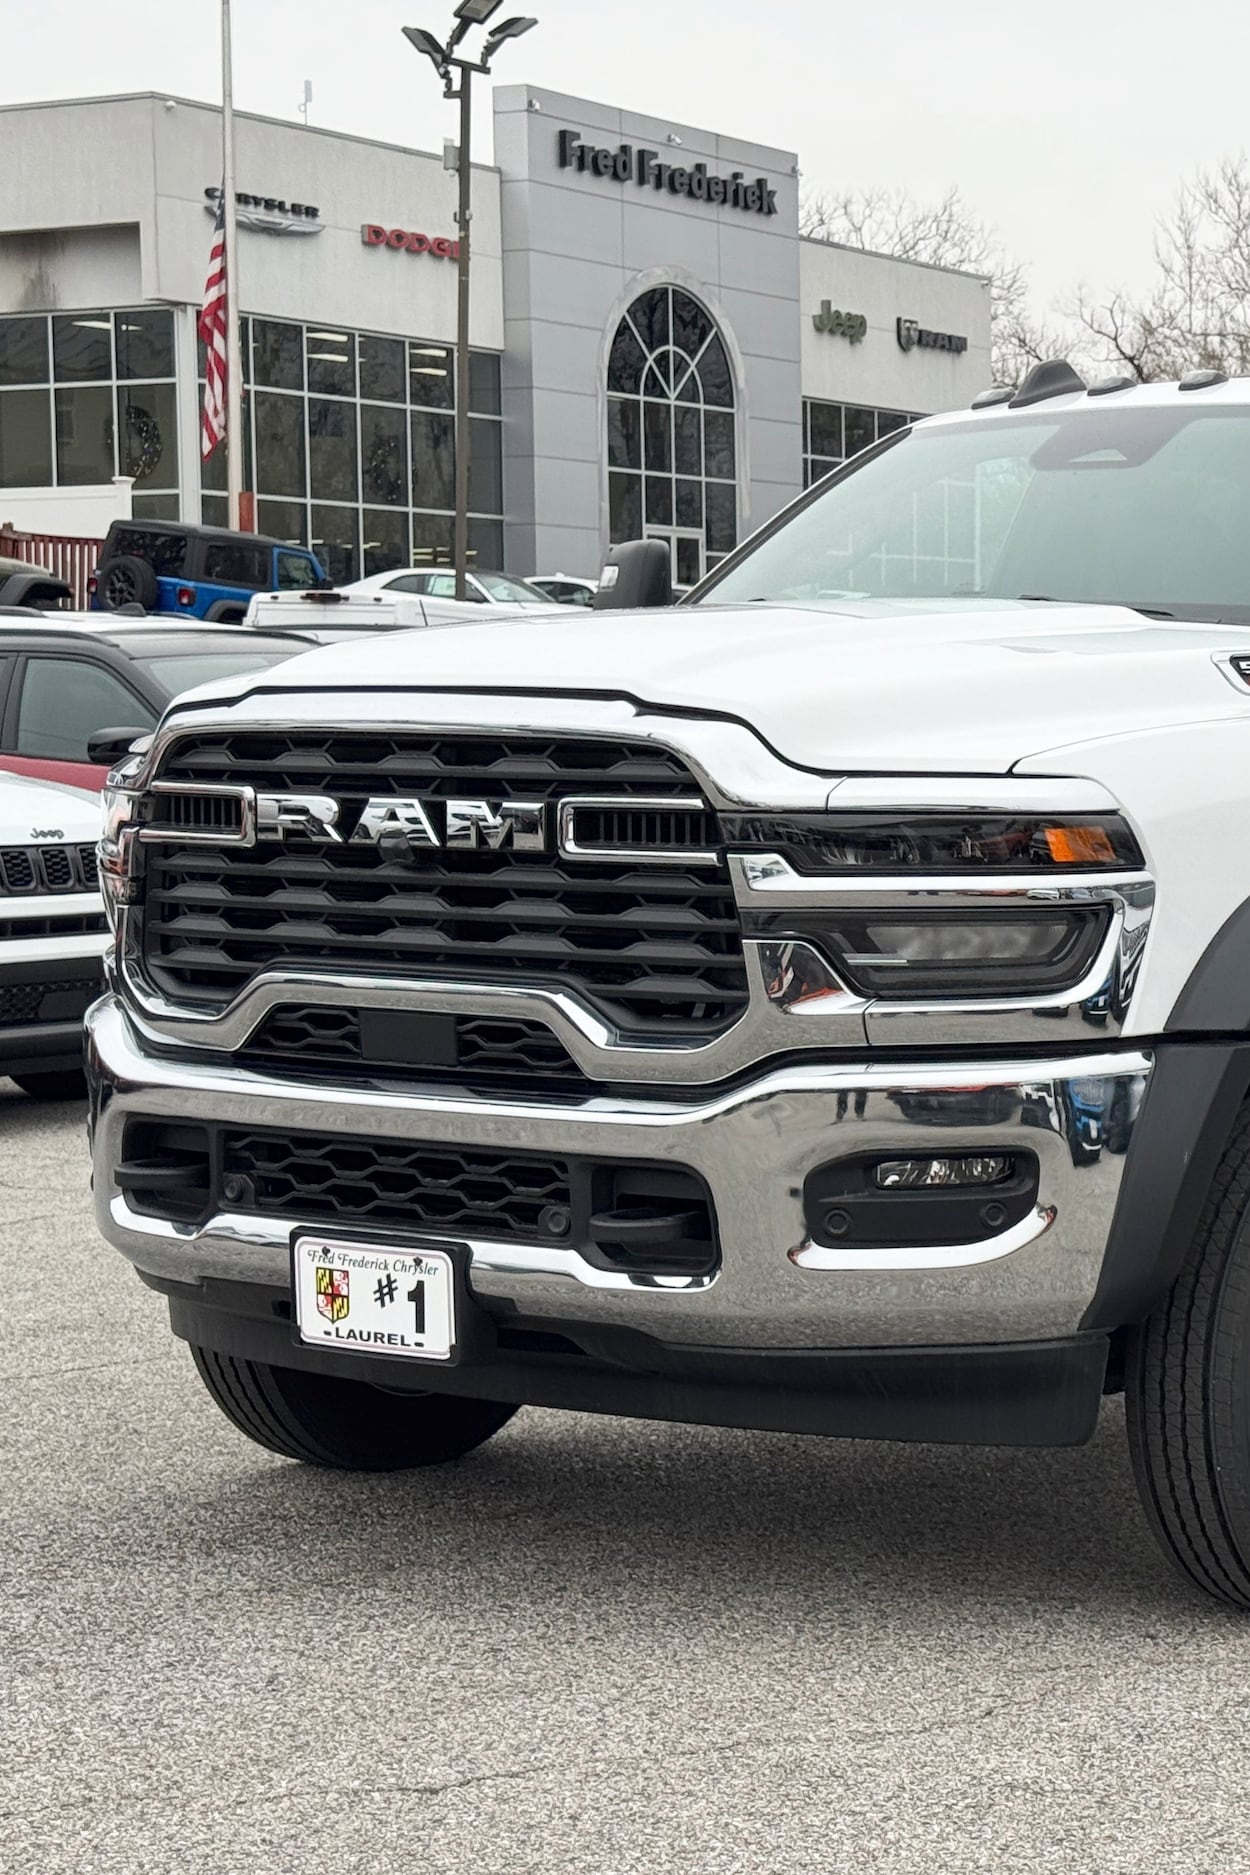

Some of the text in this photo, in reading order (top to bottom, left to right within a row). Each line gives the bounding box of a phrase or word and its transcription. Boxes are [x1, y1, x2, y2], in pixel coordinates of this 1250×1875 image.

[558, 129, 778, 215] Fred Frederick
[204, 187, 320, 218] CRYSLER
[812, 300, 867, 346] Jeep
[917, 328, 968, 354] RAM
[30, 828, 64, 840] Jeep
[256, 793, 545, 850] RAM
[307, 1249, 439, 1276] Fred Frederick Chrysler
[373, 1273, 426, 1334] #1
